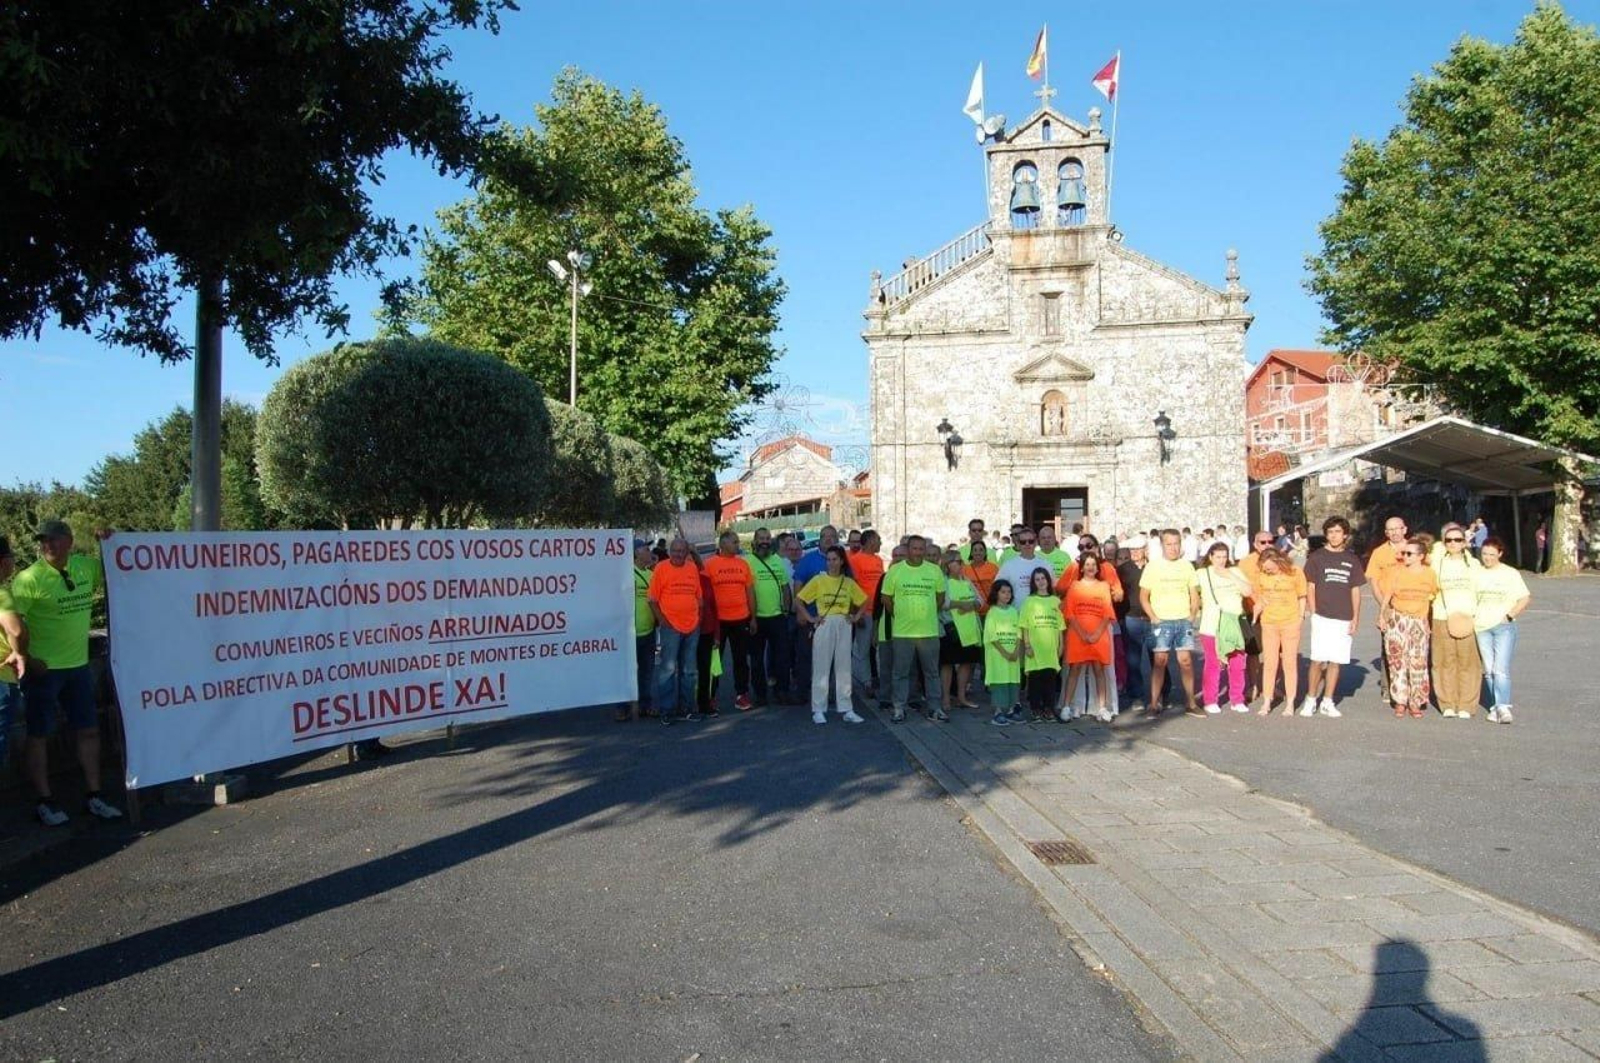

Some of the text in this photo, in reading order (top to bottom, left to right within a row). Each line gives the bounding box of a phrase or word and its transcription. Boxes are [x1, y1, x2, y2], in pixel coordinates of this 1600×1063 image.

[115, 537, 626, 571] COMUNEIROS, PAGAREDES COS VOSOS CARTOS AS
[196, 574, 577, 617] INDEMNIZACIÓNS DOS DEMANDADOS?
[215, 611, 566, 662] COMUNEIROS E VECIÑOS ARRUINADOS
[141, 637, 618, 709] POLA DIRECTIVA DA COMUNIDADE DE MONTES DE CABRAL
[293, 672, 506, 734] DESLINDE XA!
